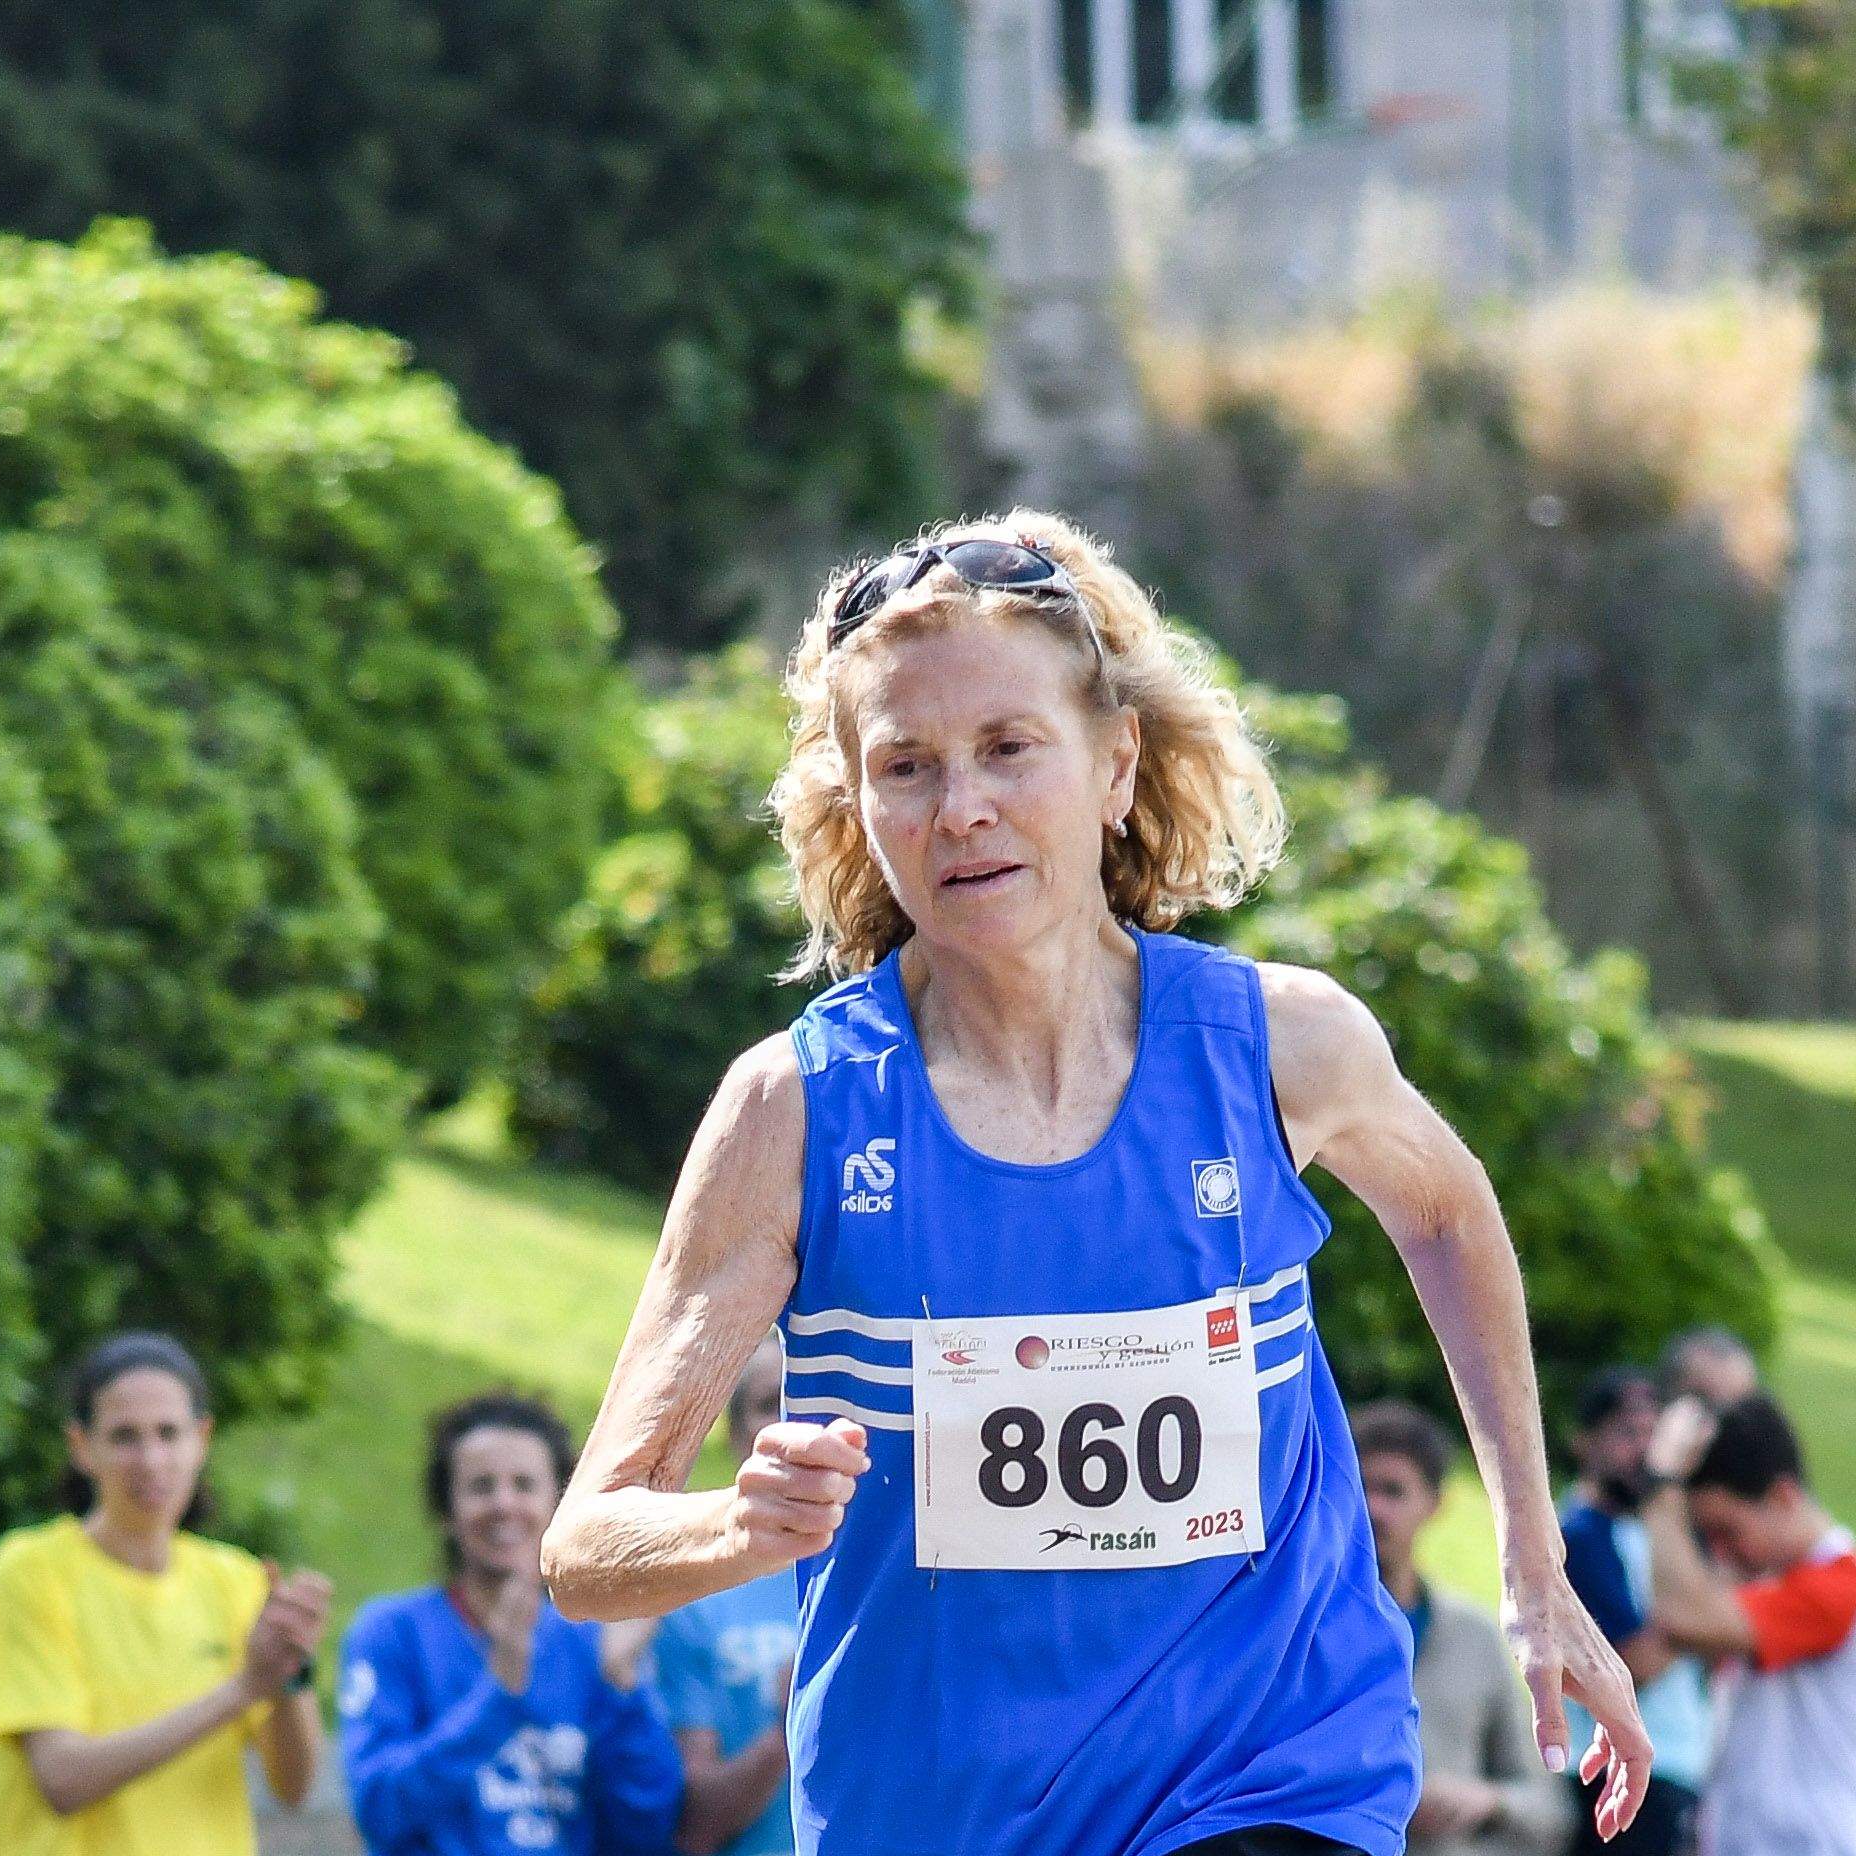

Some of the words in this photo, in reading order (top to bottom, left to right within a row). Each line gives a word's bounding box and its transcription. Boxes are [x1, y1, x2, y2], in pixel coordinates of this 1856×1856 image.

[1050, 1334, 1143, 1350] RIESGO
[978, 1394, 1203, 1508] 860
[1089, 1525, 1157, 1551] rasán
[1185, 1508, 1244, 1542] 2023
